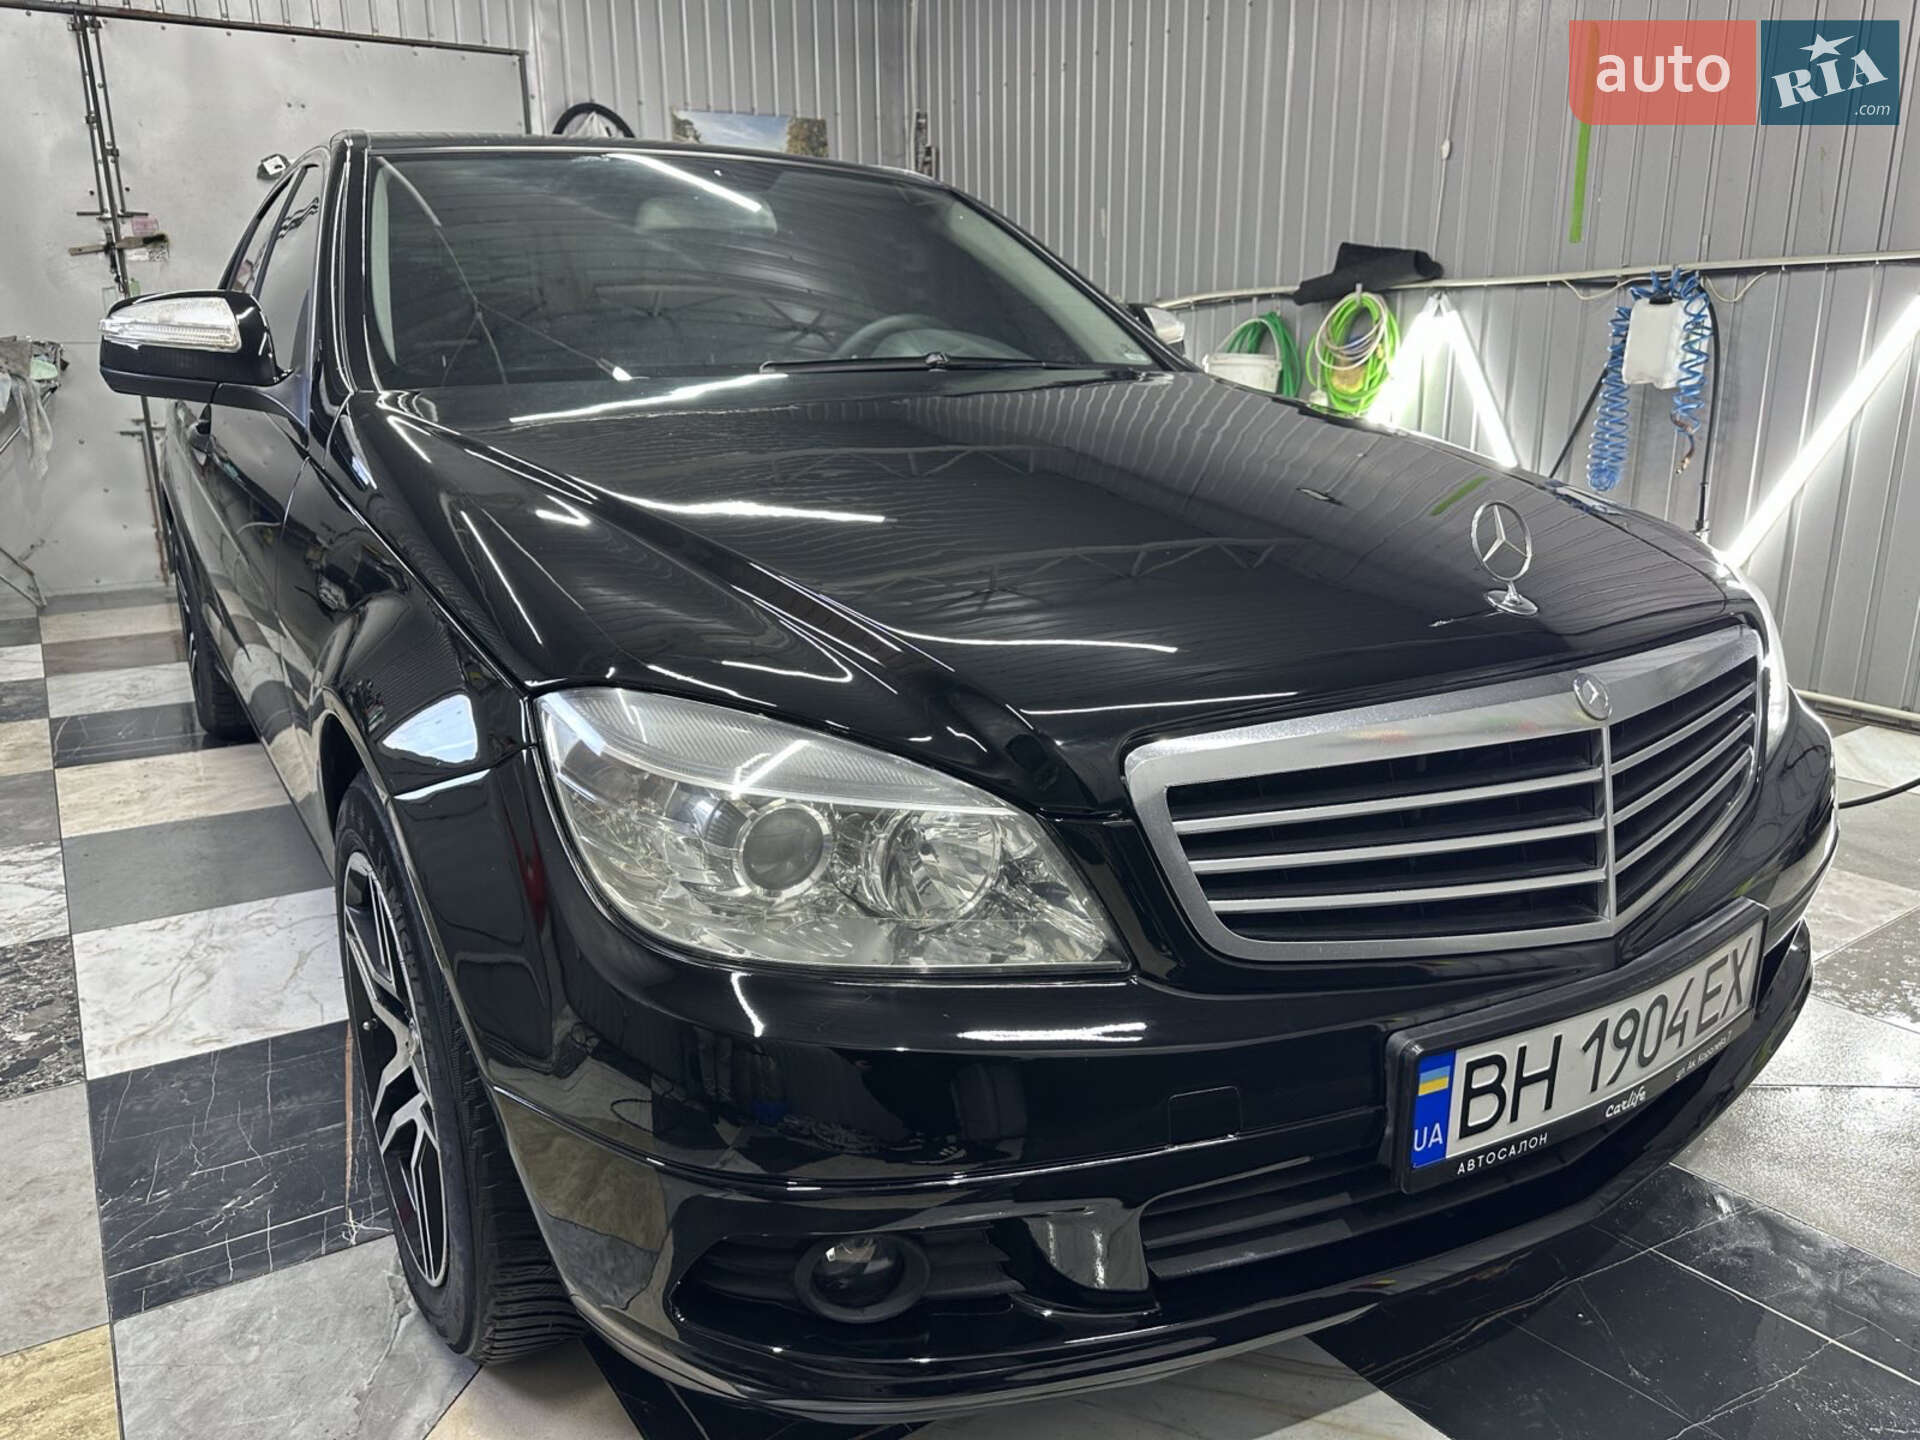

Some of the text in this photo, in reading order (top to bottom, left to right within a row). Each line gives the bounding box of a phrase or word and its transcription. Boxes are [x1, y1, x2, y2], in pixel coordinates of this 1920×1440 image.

[1458, 1034, 1563, 1140] BH
[1581, 976, 1695, 1094] 1904
[1695, 935, 1753, 1038] EX
[1604, 1085, 1647, 1118] Carlife
[1413, 1122, 1444, 1152] UA
[1457, 1132, 1549, 1175] АВТОСАЛОН
